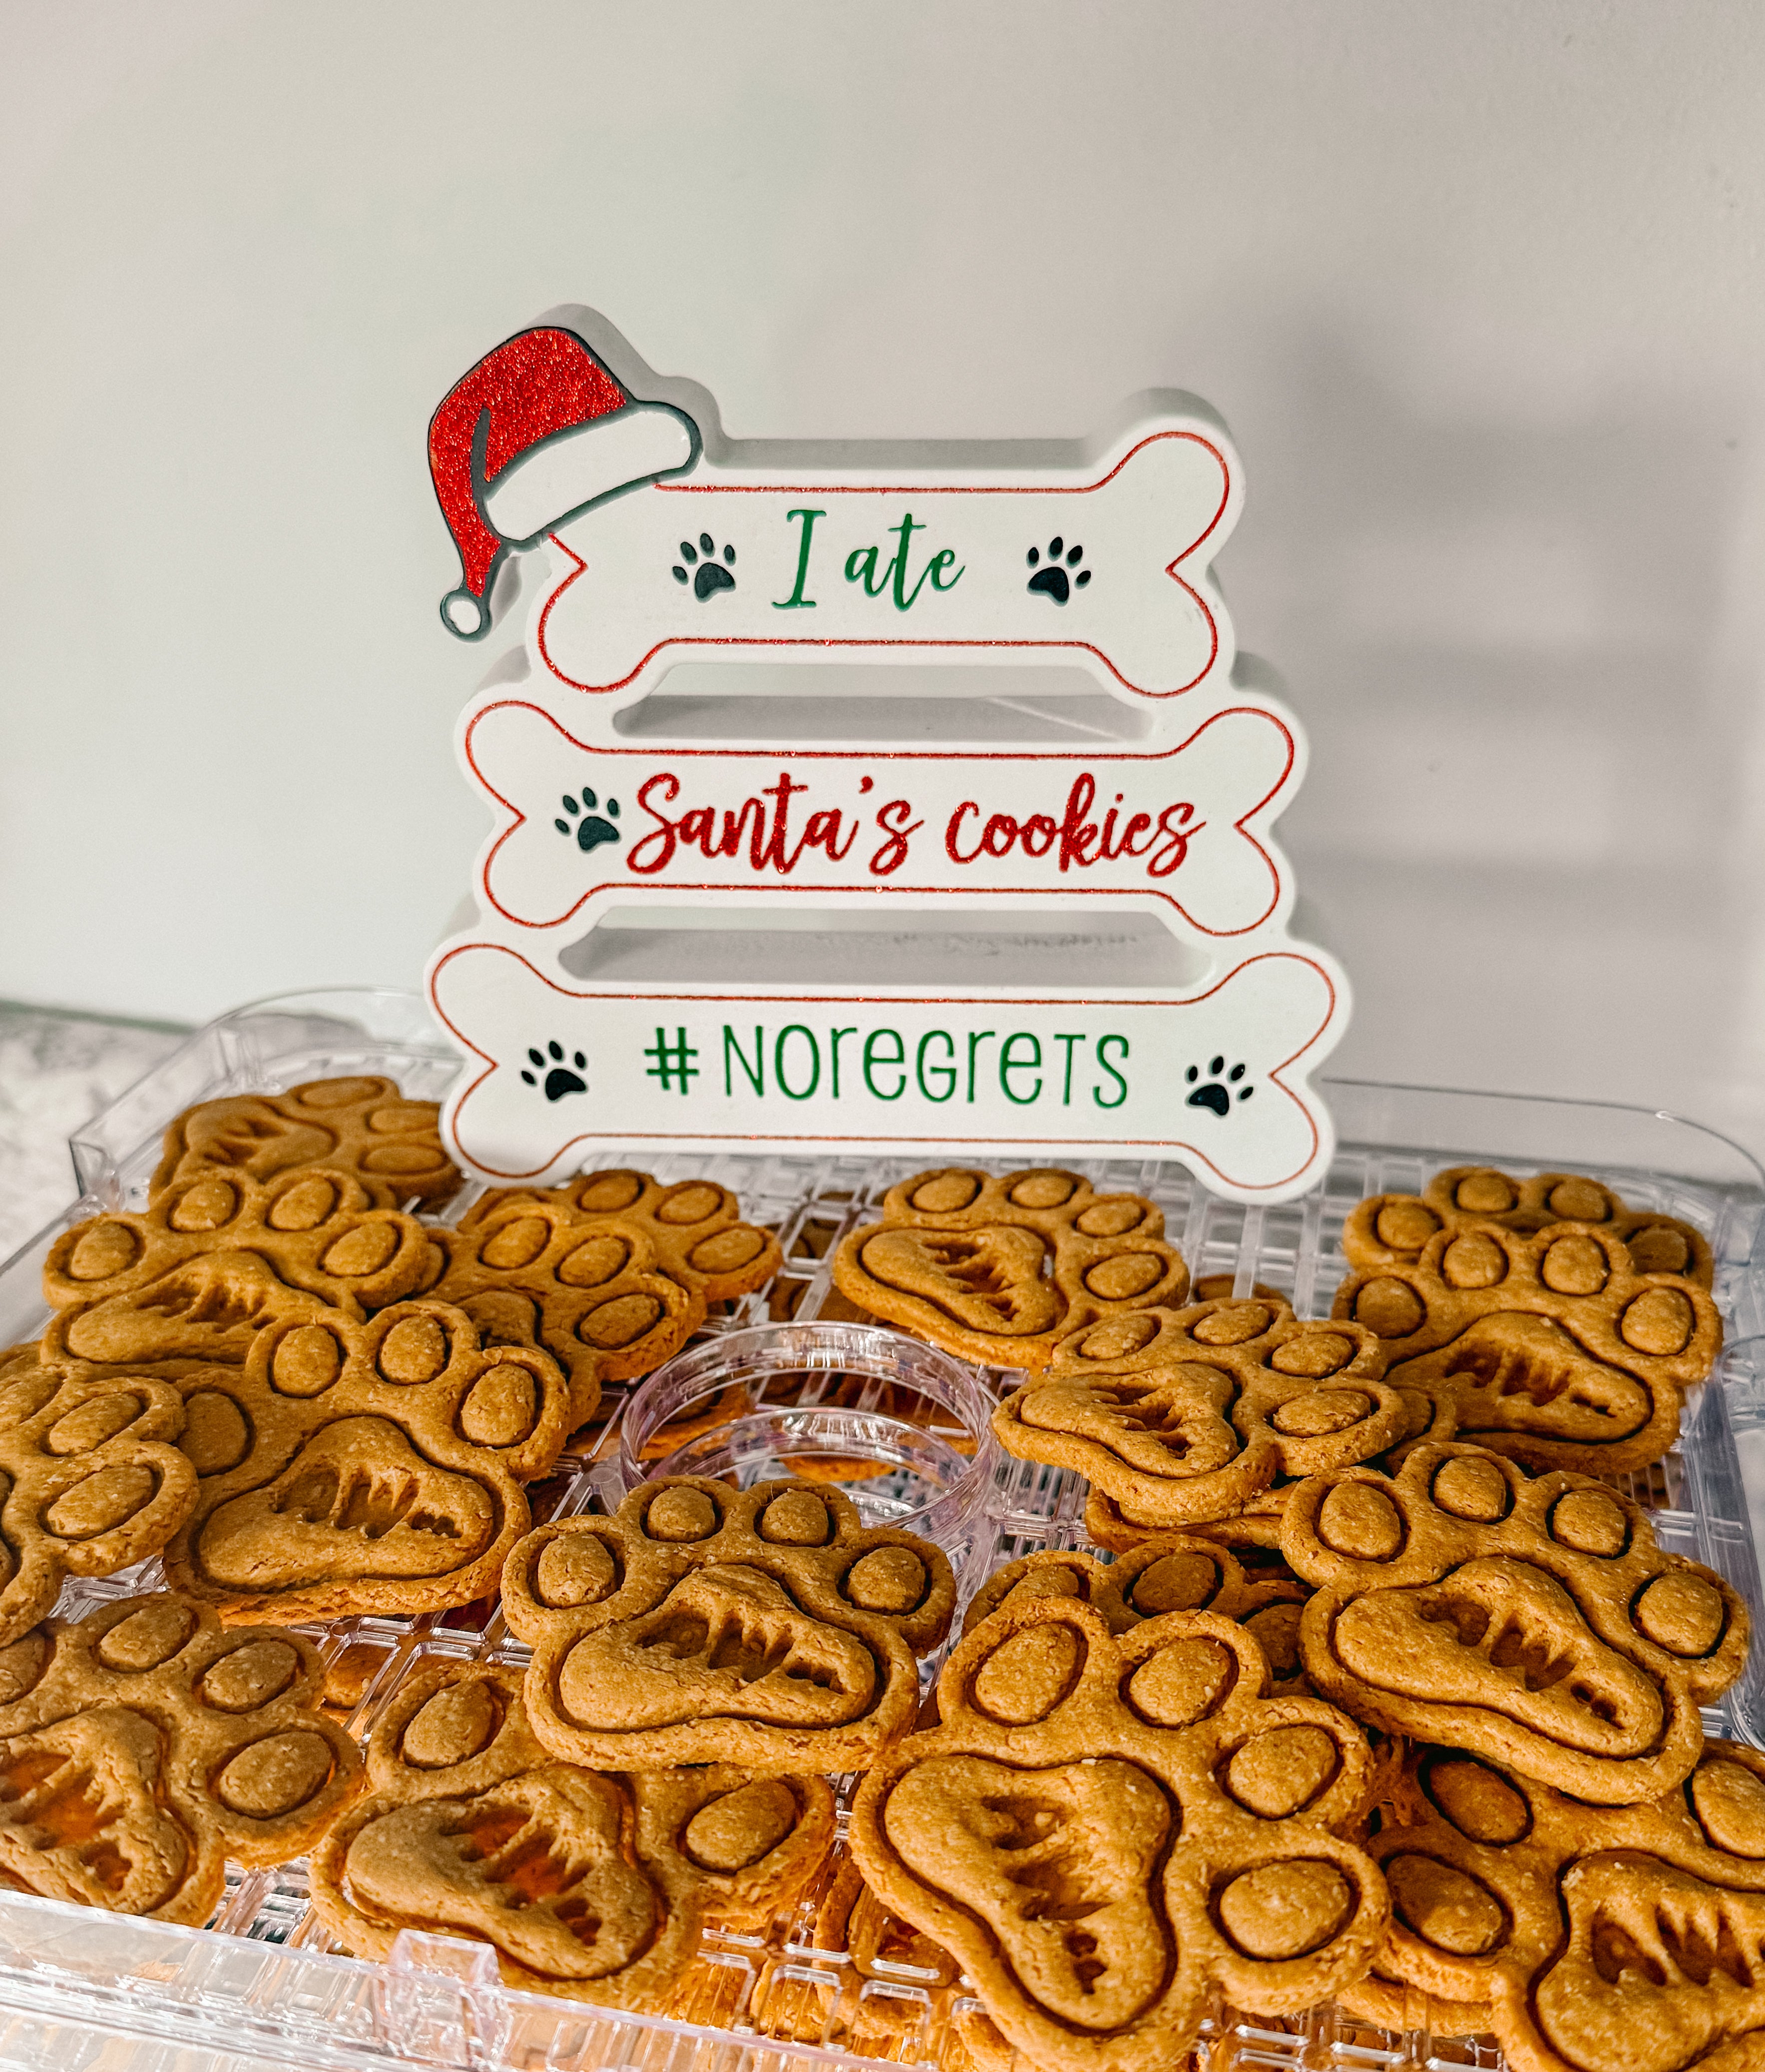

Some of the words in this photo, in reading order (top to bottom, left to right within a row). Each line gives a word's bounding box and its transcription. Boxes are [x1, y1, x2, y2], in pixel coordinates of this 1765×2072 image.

[772, 509, 827, 609] I
[844, 513, 965, 611] ate
[626, 772, 924, 877] Santa's
[944, 772, 1207, 878] cookies
